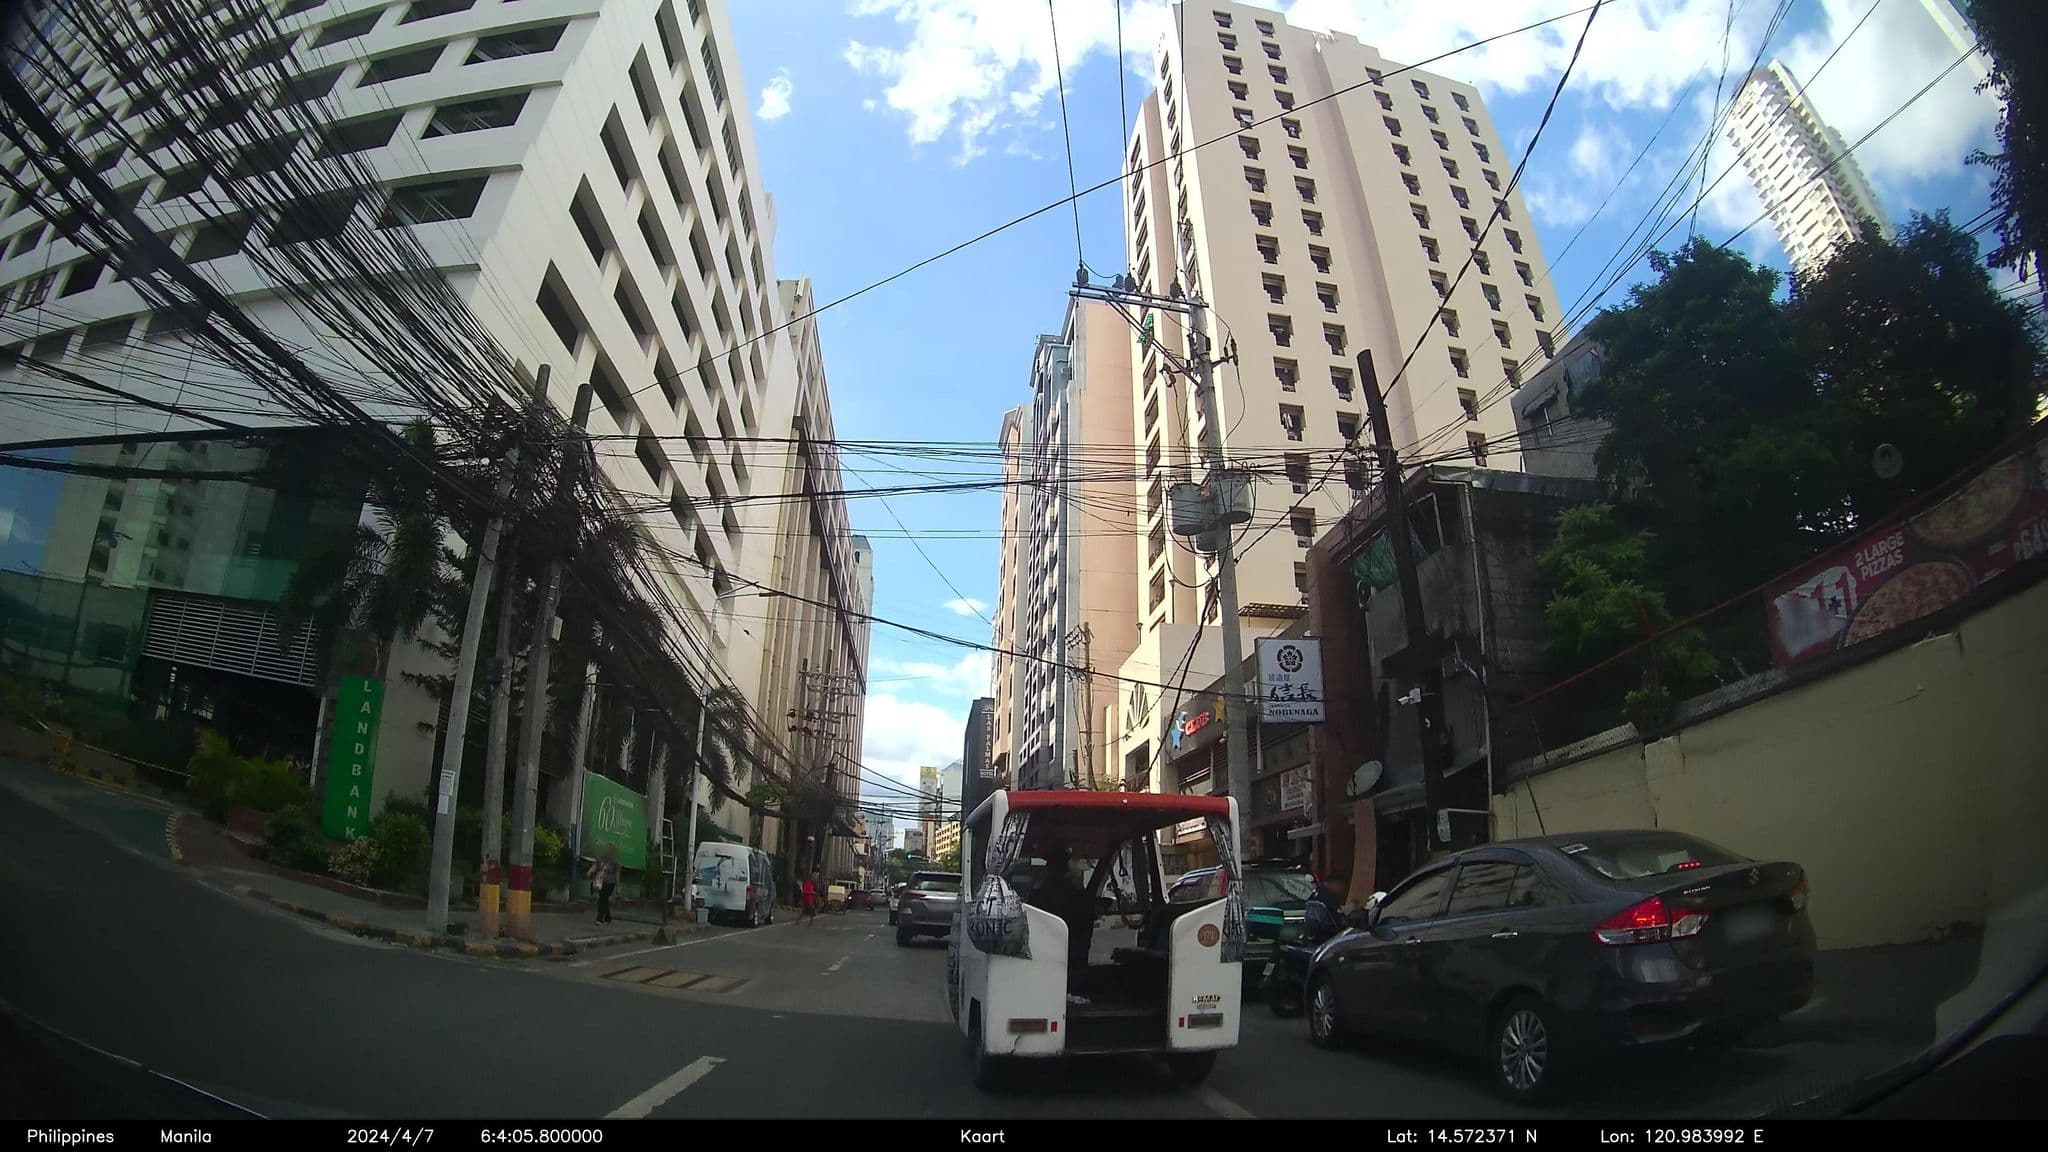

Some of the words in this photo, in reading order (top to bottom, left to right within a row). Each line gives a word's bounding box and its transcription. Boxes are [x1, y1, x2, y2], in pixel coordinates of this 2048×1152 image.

[1855, 552, 1864, 568] 2
[1864, 531, 1905, 563] LARGE
[1861, 549, 1904, 581] PIZZAS
[345, 680, 372, 840] LANDBANK
